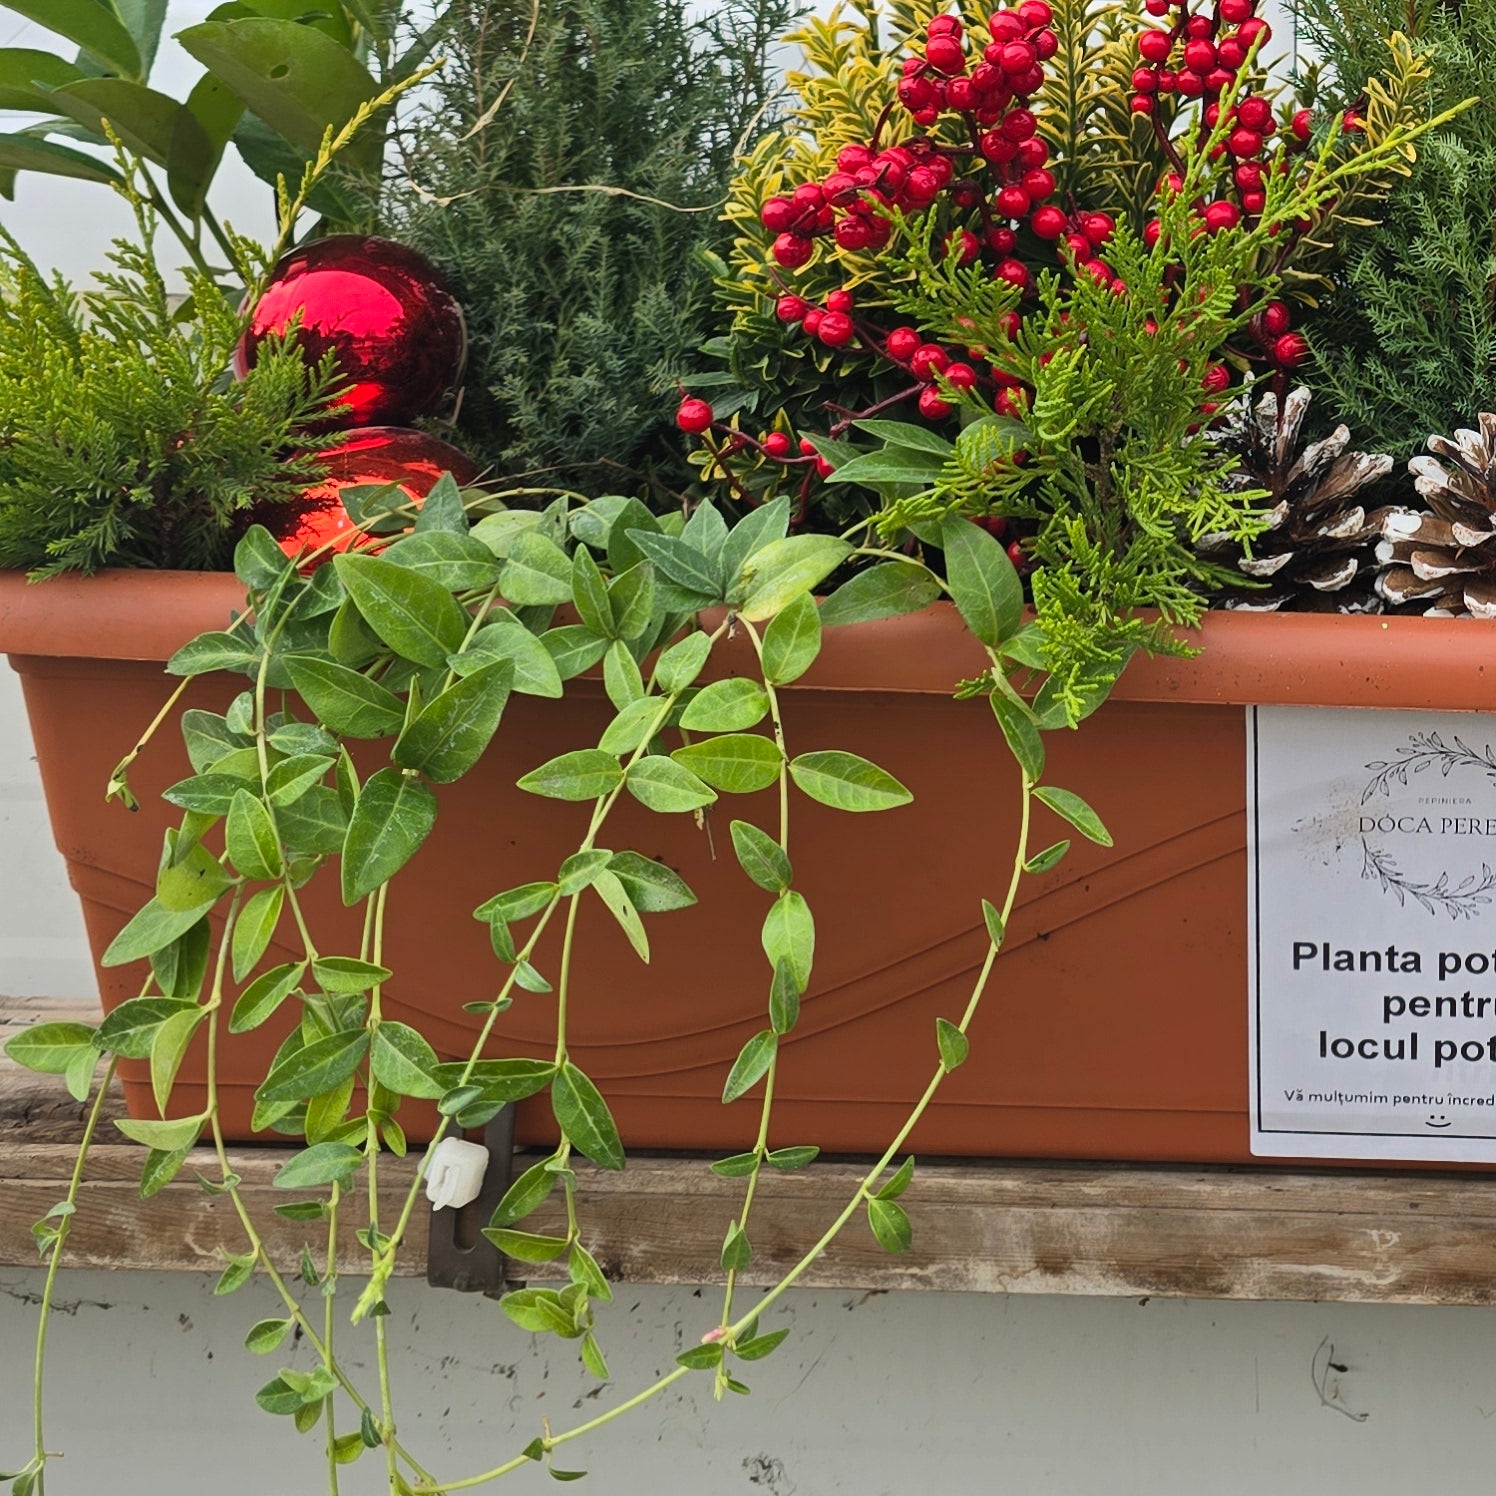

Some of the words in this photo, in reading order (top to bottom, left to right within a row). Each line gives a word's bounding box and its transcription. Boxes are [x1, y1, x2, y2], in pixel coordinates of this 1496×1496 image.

[1293, 941, 1422, 974] Planta
[1319, 1030, 1418, 1061] locul
[1283, 1088, 1304, 1102] Vă
[1393, 1093, 1444, 1108] pentru
